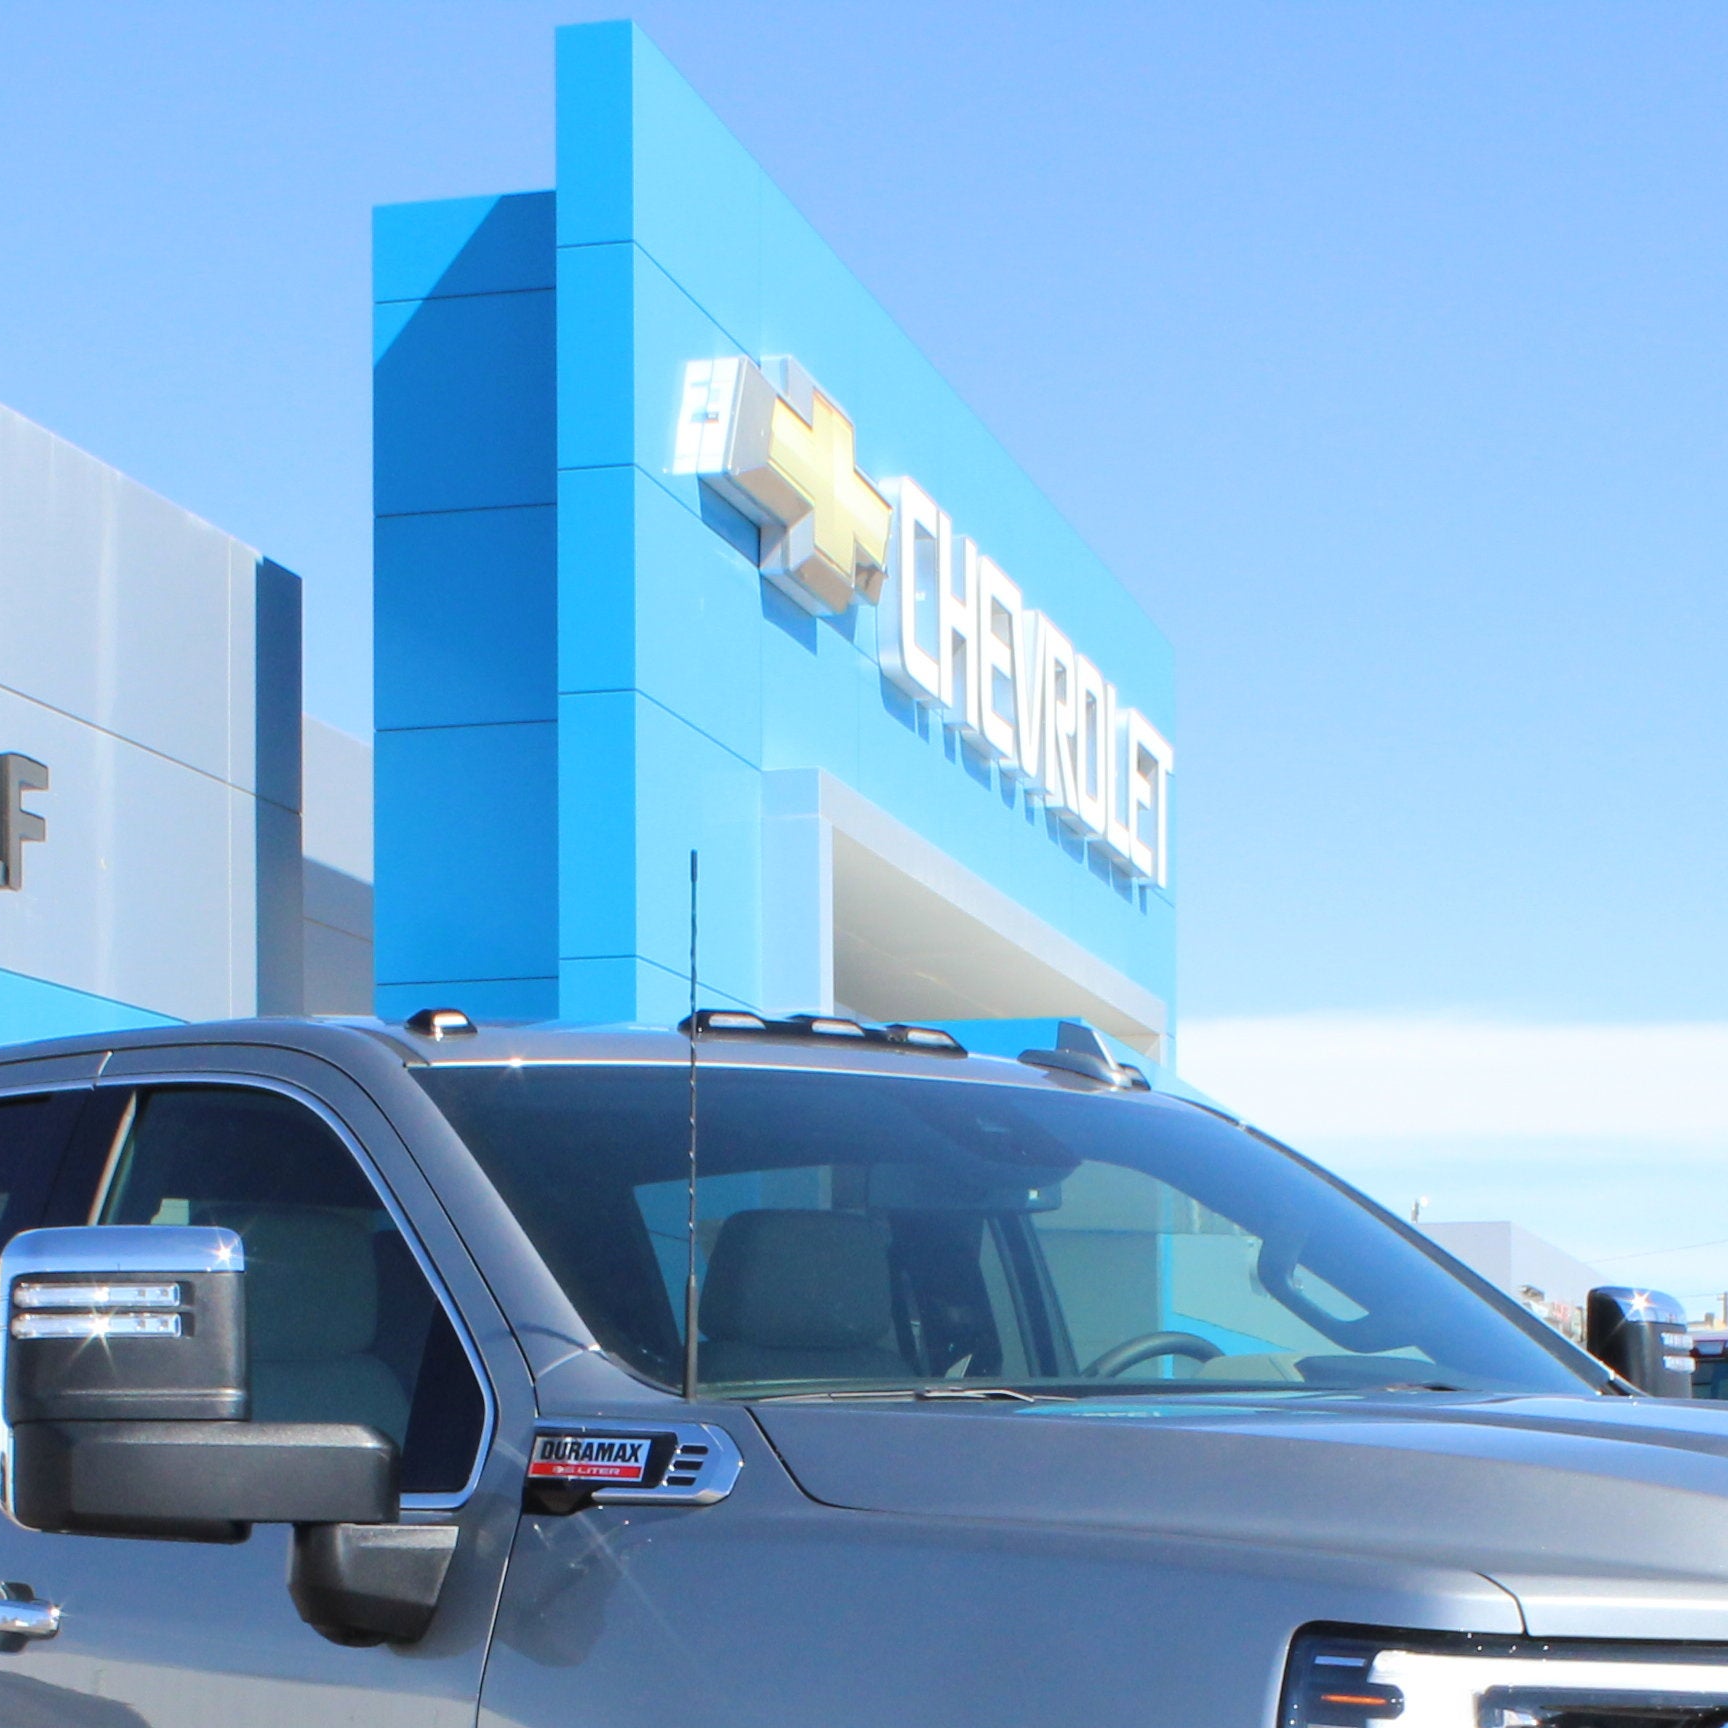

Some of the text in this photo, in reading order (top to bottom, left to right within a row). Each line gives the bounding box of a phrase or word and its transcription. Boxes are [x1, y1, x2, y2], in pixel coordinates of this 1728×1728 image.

[878, 476, 1173, 889] CHEVROLET
[540, 1440, 643, 1463] DURAMAX
[577, 1466, 621, 1475] LITER
